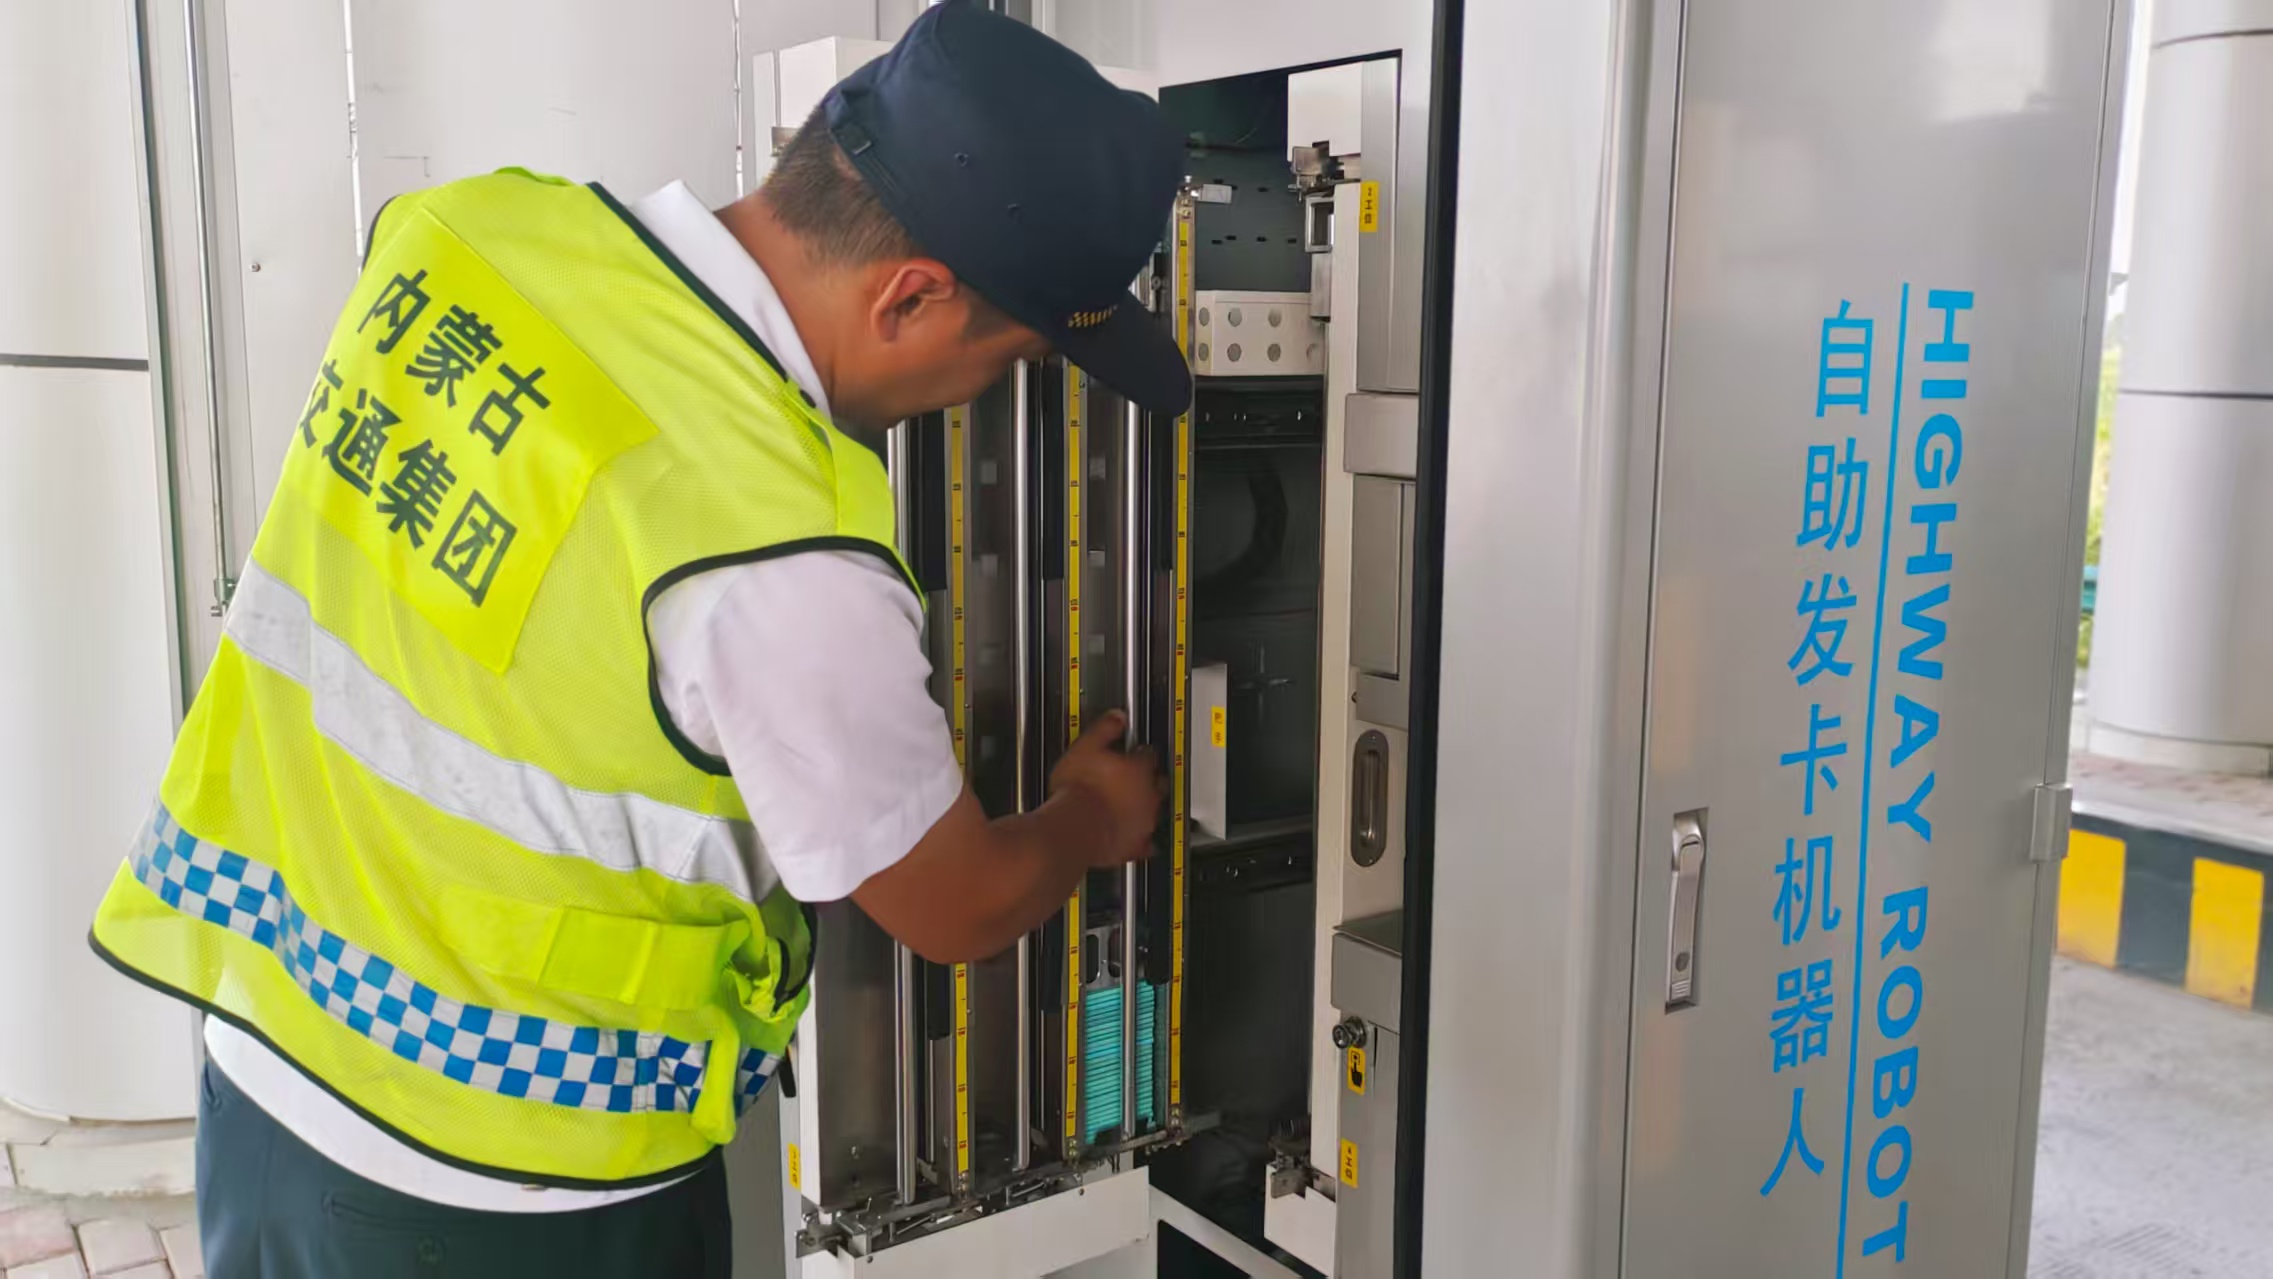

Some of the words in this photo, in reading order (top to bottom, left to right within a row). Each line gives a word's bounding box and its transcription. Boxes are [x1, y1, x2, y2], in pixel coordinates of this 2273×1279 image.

[356, 269, 551, 456] 内蒙古
[1886, 288, 1975, 843] HIGHWAY
[1759, 299, 1874, 1197] 自助发卡机器人
[1862, 885, 1929, 1263] ROBOT
